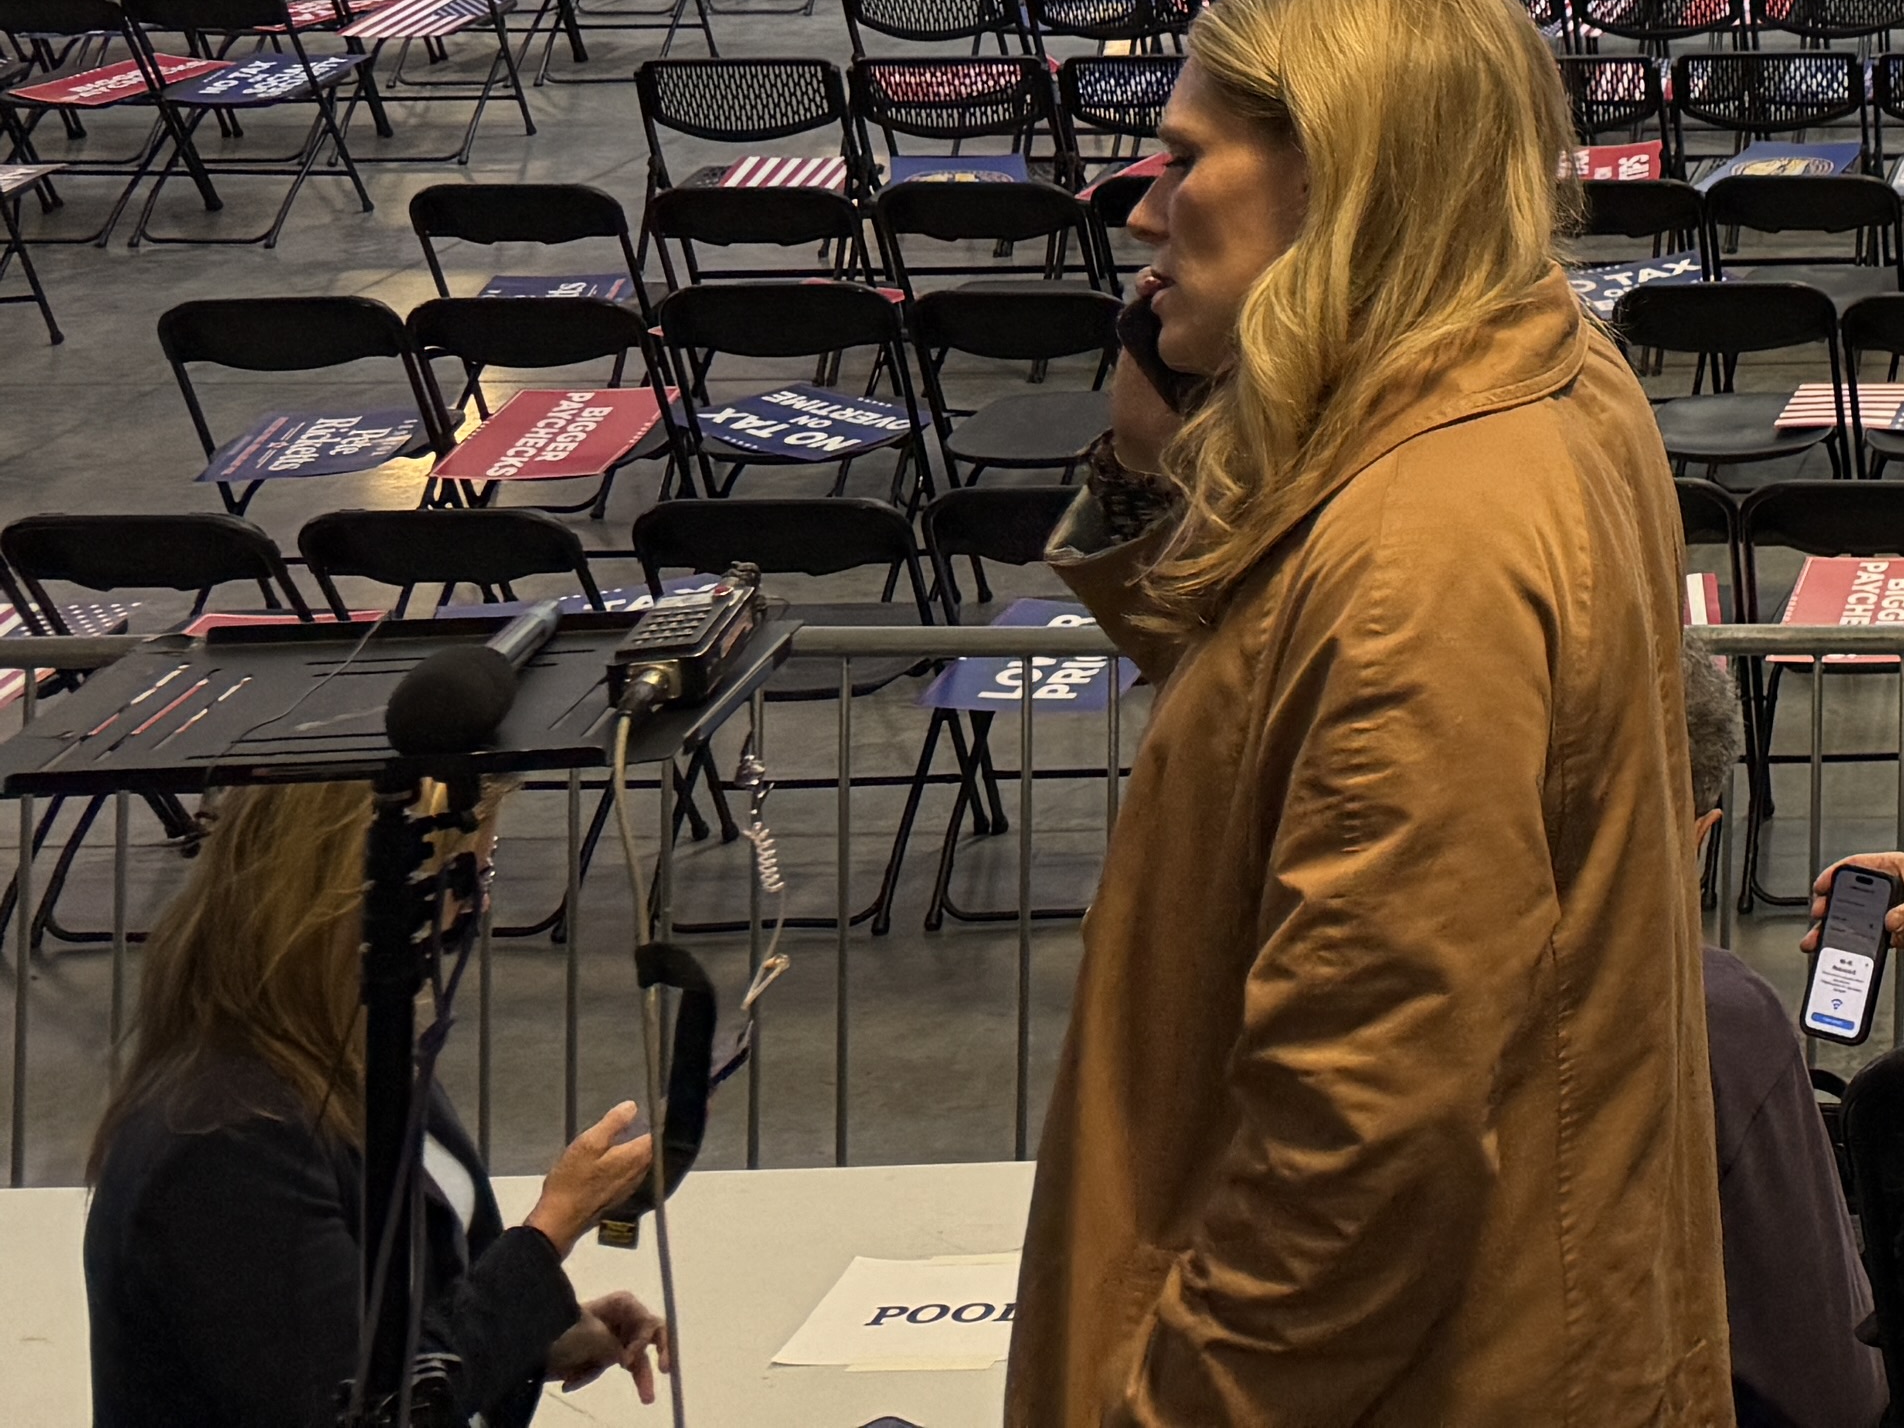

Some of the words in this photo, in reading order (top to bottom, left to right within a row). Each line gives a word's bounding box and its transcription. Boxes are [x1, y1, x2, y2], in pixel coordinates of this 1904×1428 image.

[1604, 258, 1702, 286] TAX
[696, 407, 790, 438] TAX
[761, 391, 911, 430] OVERTIME
[789, 415, 832, 428] ON
[268, 416, 363, 471] Ricketts
[330, 427, 392, 455] Pete
[486, 392, 596, 477] PAYCHECKS
[535, 406, 614, 462] BIGGER
[784, 431, 862, 451] NO
